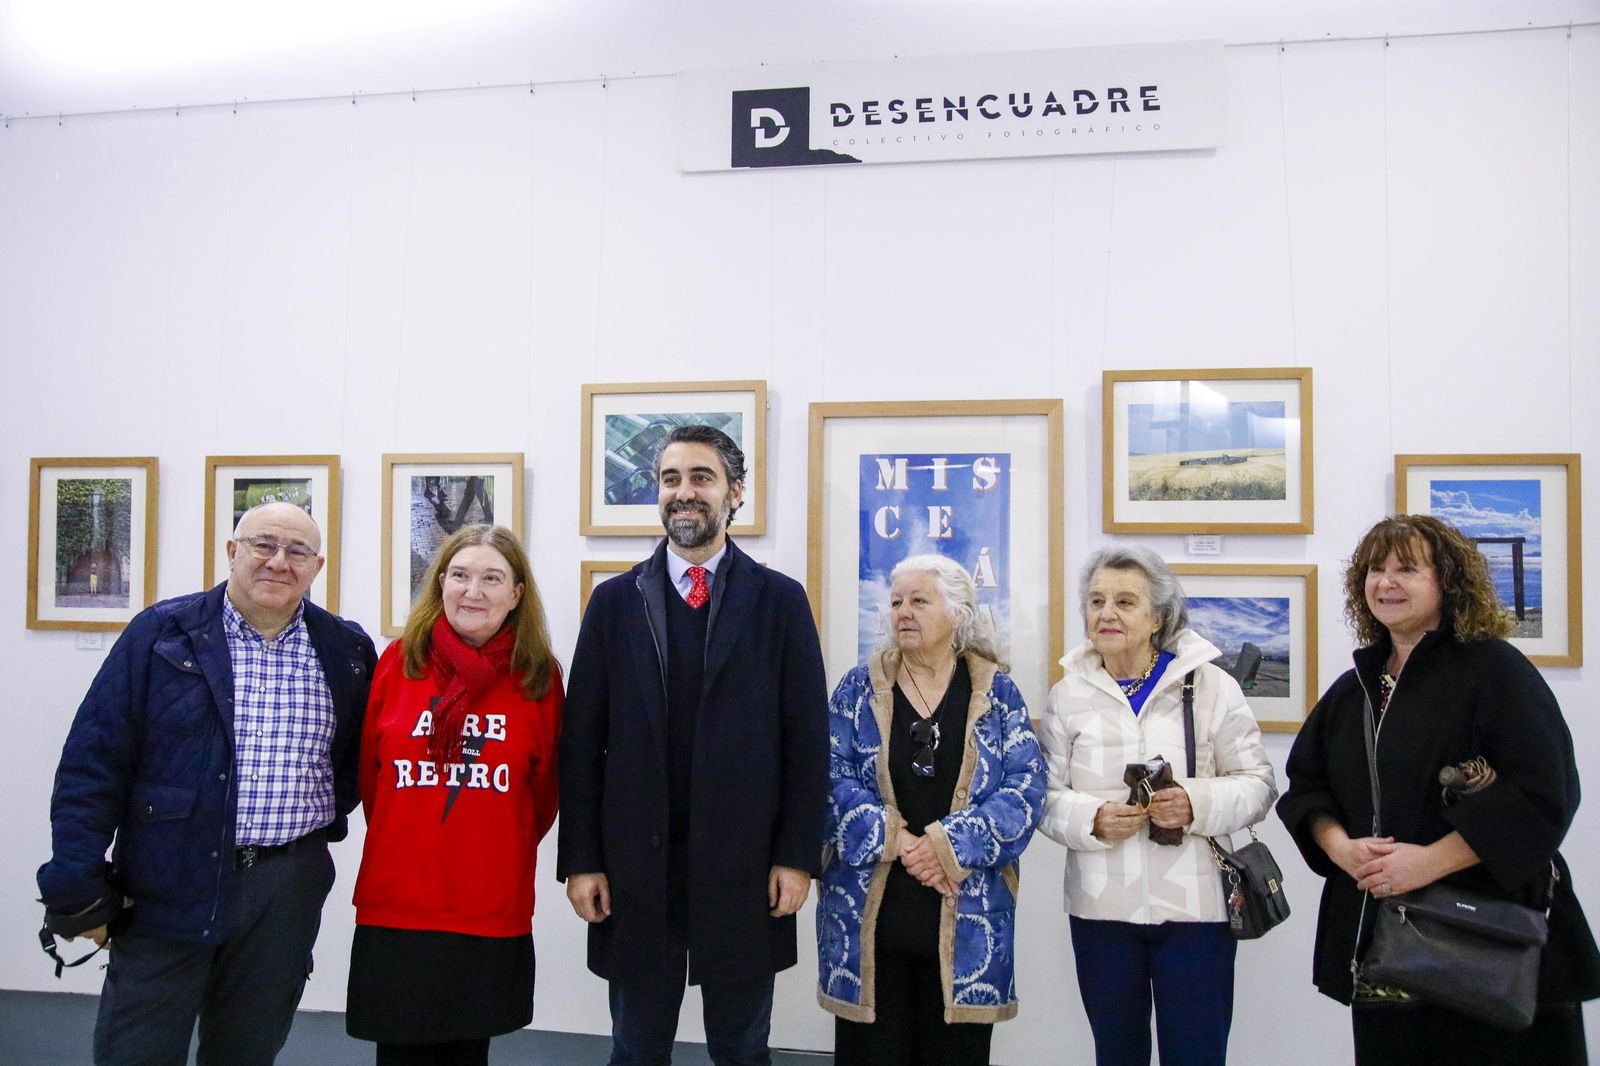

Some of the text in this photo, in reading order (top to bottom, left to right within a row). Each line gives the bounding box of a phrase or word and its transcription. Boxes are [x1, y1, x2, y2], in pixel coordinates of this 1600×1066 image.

[829, 85, 1161, 128] DESENCUADRE
[832, 133, 964, 146] COLECTIVO
[411, 710, 507, 741] ARE
[393, 759, 510, 793] RETRO
